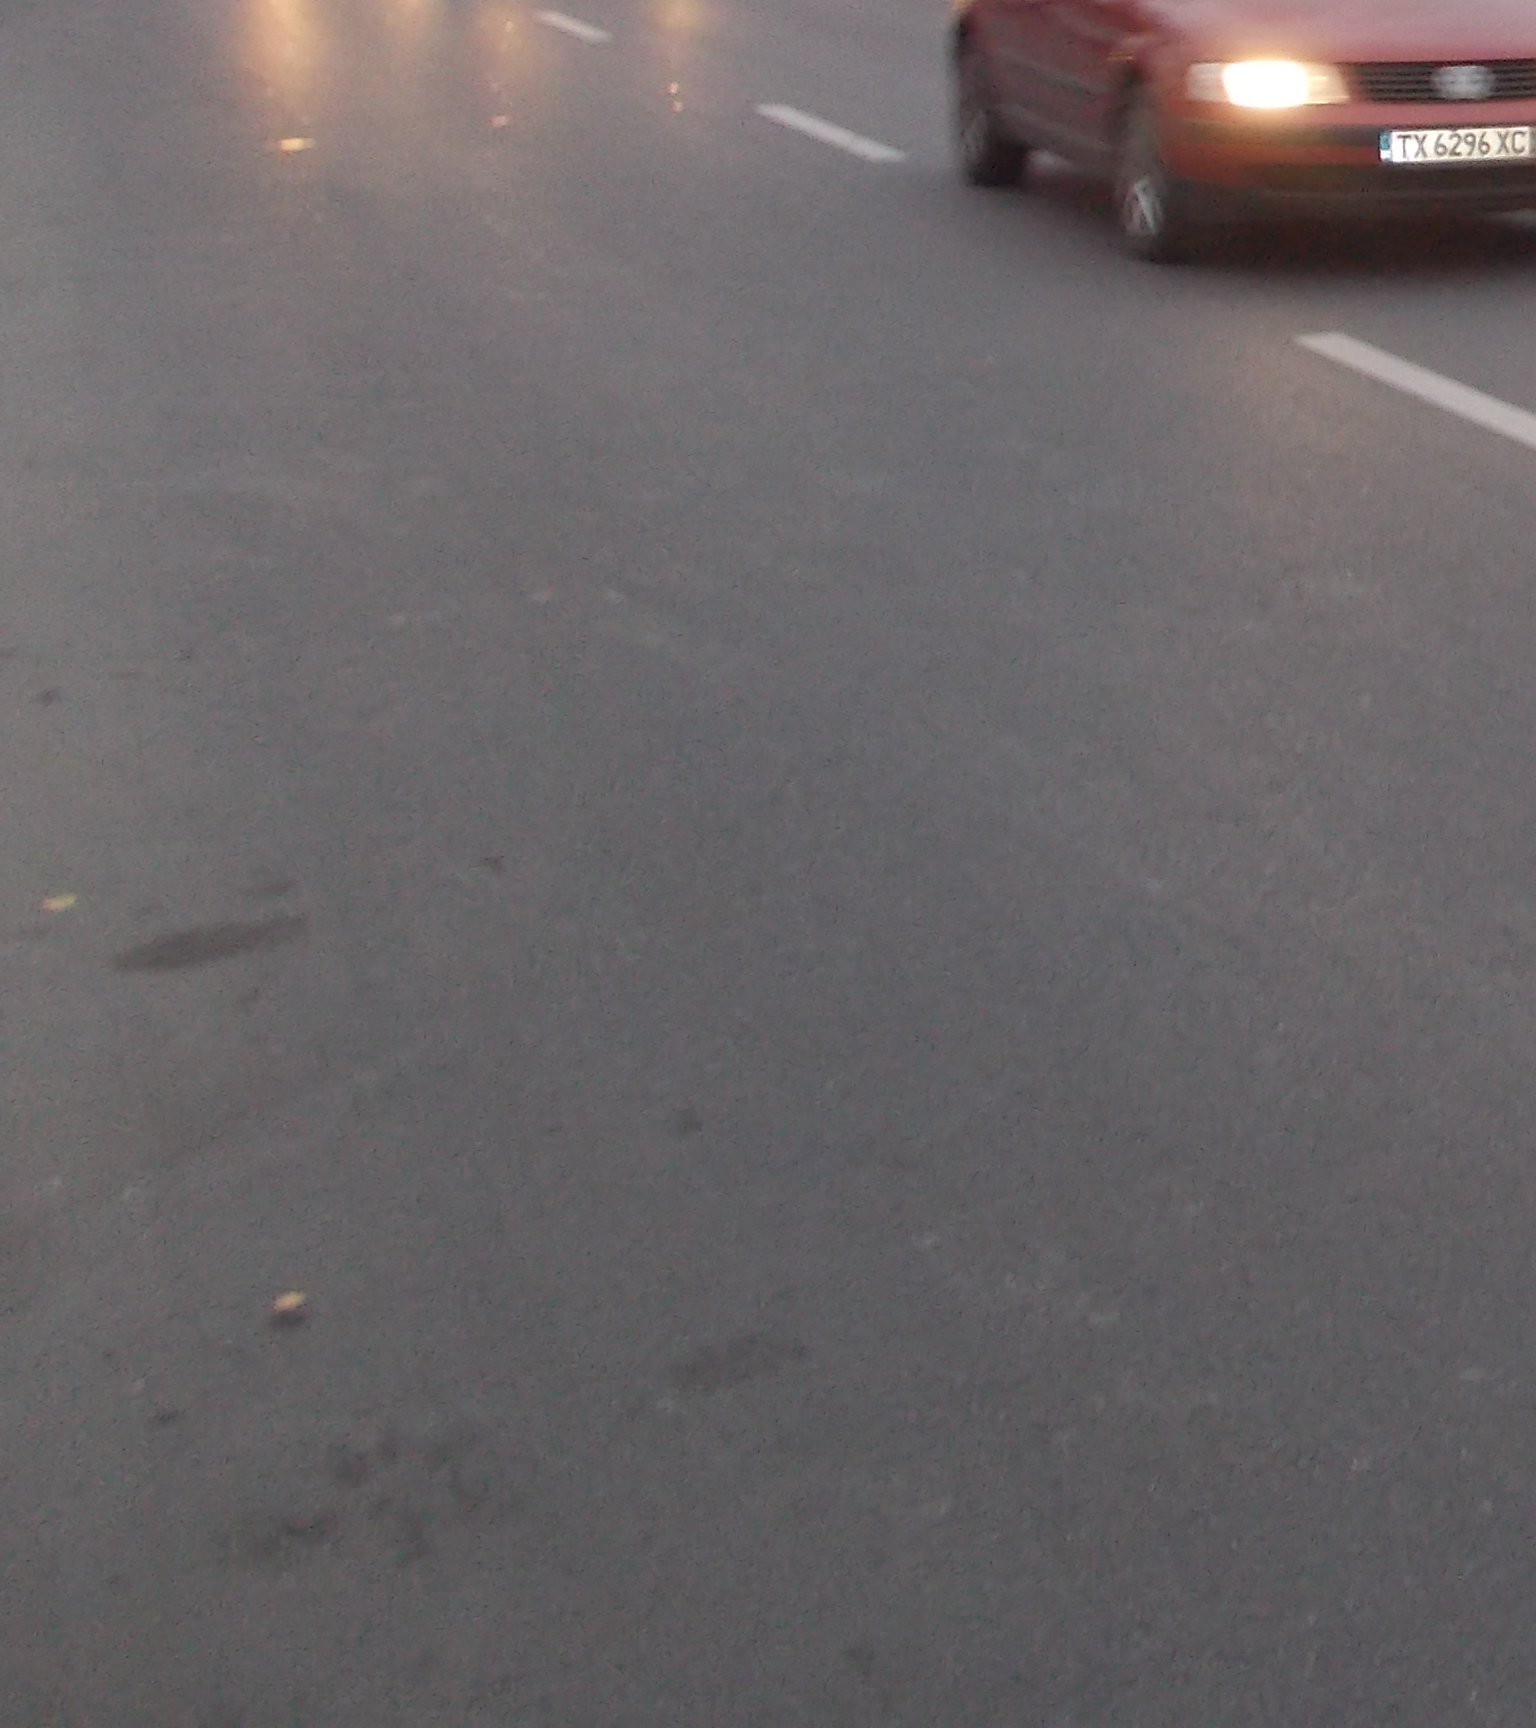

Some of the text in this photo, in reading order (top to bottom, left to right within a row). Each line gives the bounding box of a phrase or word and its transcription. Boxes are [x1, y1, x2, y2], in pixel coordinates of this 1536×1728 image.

[1396, 129, 1527, 159] TX 6296 XC
